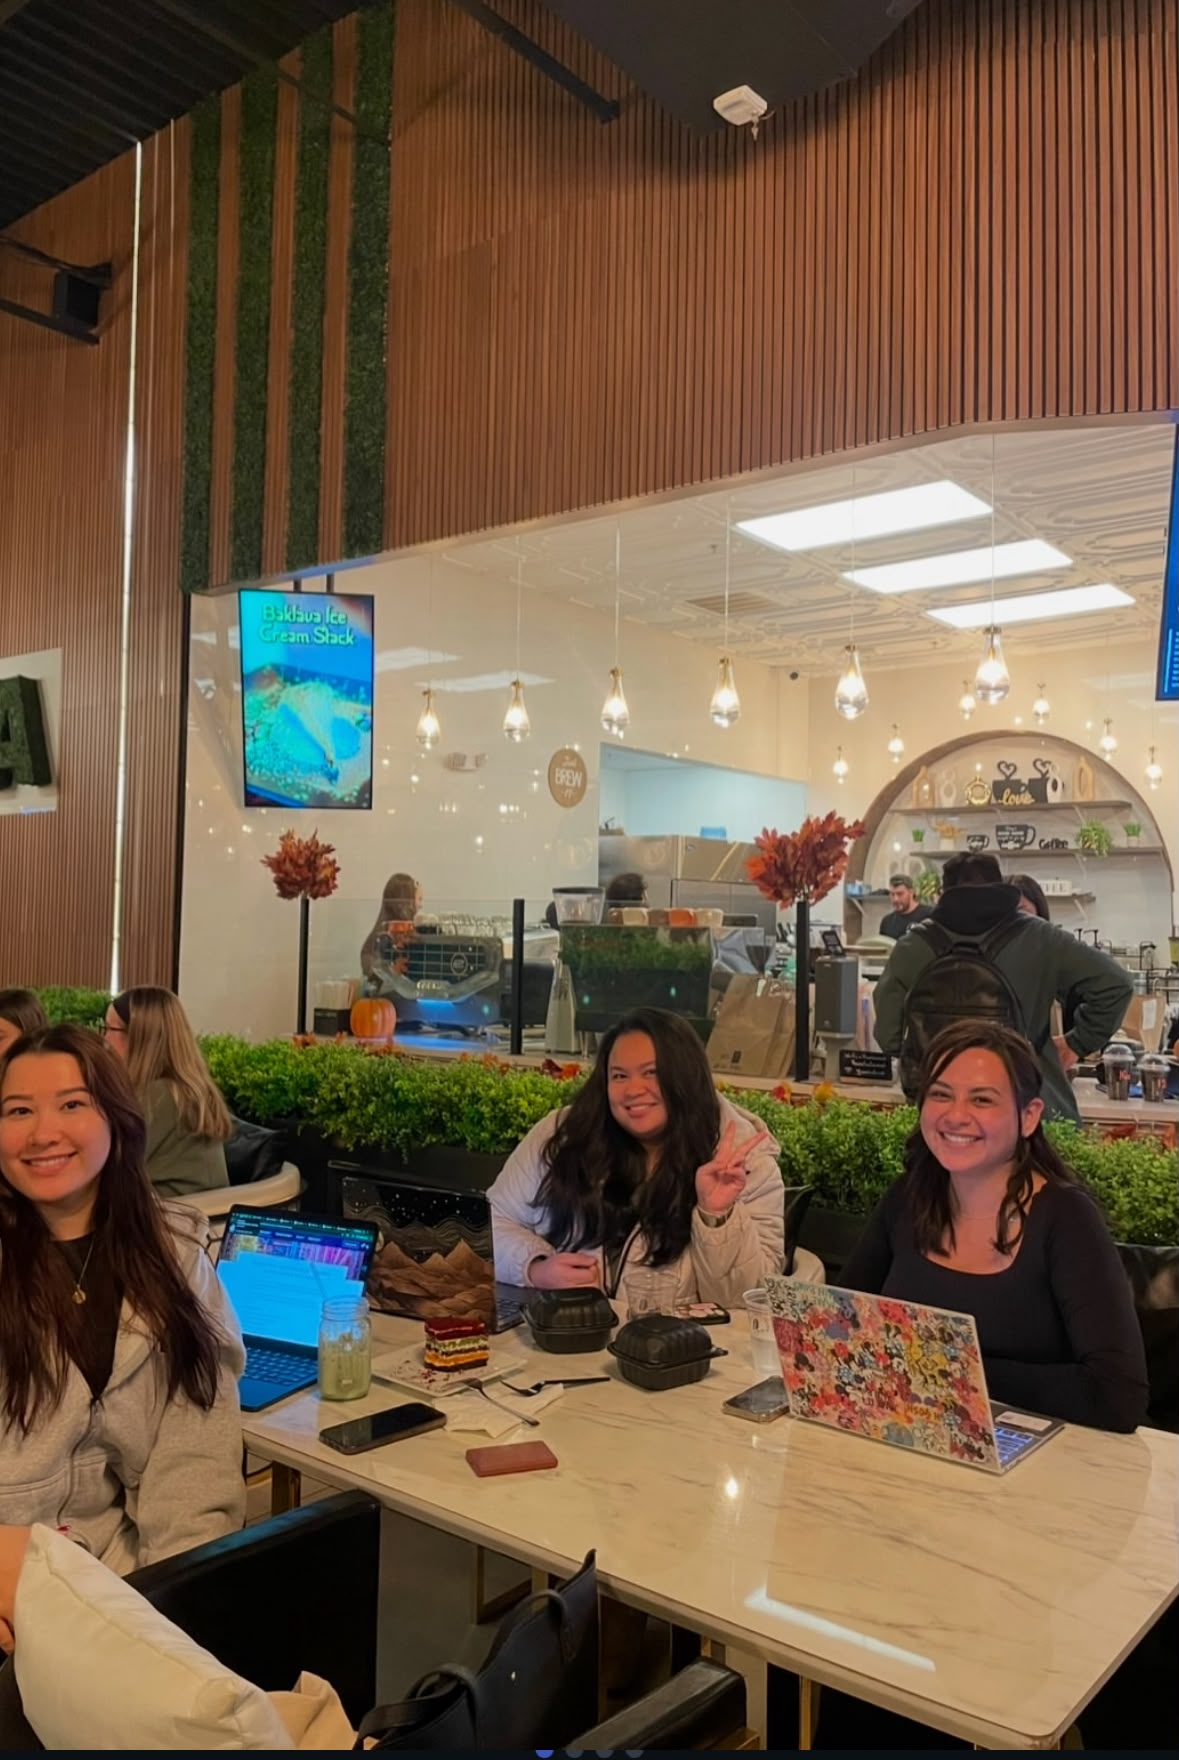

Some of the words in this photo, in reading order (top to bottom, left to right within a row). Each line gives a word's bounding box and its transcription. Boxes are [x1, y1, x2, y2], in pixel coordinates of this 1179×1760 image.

[263, 604, 321, 623] Baklava
[325, 604, 347, 624] Ice
[259, 624, 309, 643] Cream
[313, 625, 354, 646] Stack
[554, 767, 582, 788] BREW
